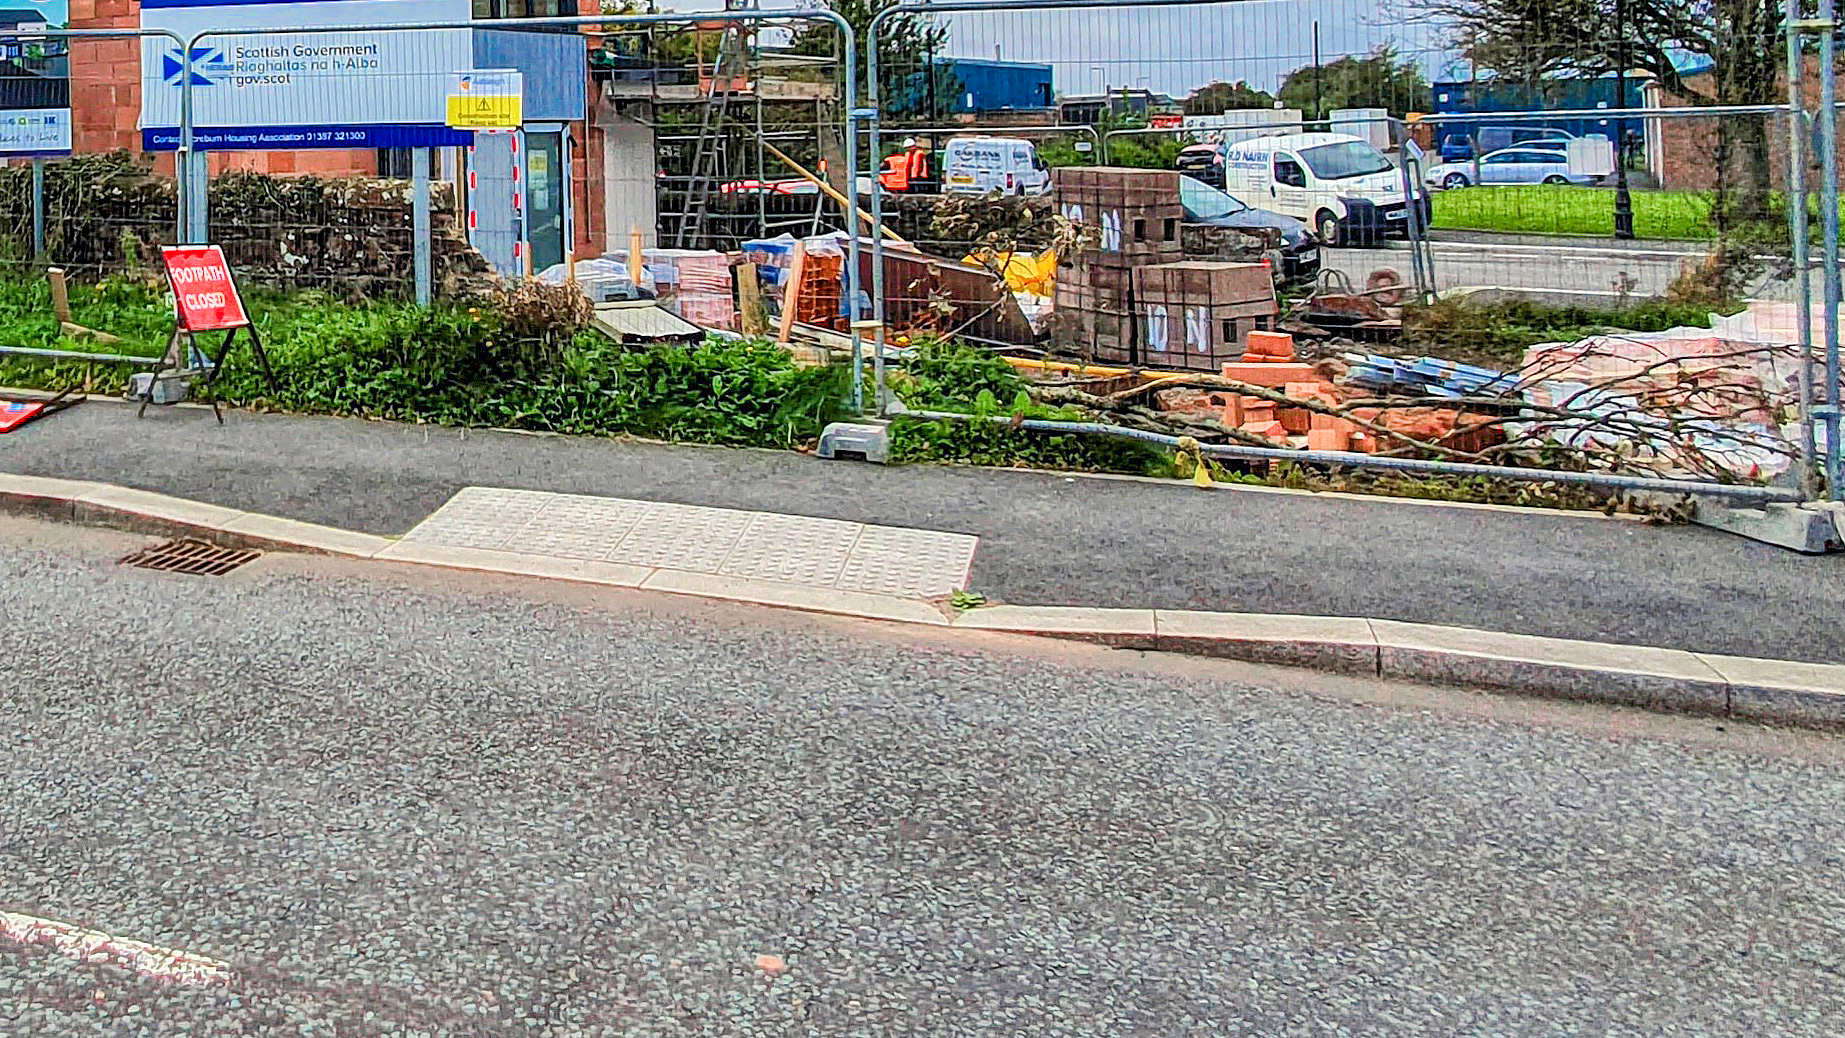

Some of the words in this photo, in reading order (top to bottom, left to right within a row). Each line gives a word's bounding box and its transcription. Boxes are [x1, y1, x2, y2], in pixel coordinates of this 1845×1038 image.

[236, 44, 289, 59] Scottish
[293, 43, 378, 58] Government
[236, 58, 307, 75] Riaghaltas
[311, 61, 329, 70] na
[332, 57, 378, 69] h-Alba
[236, 73, 291, 87] gov.scot
[153, 135, 181, 144] Contac
[224, 133, 257, 144] Housing
[258, 132, 305, 142] Association
[186, 292, 226, 310] CLOSED
